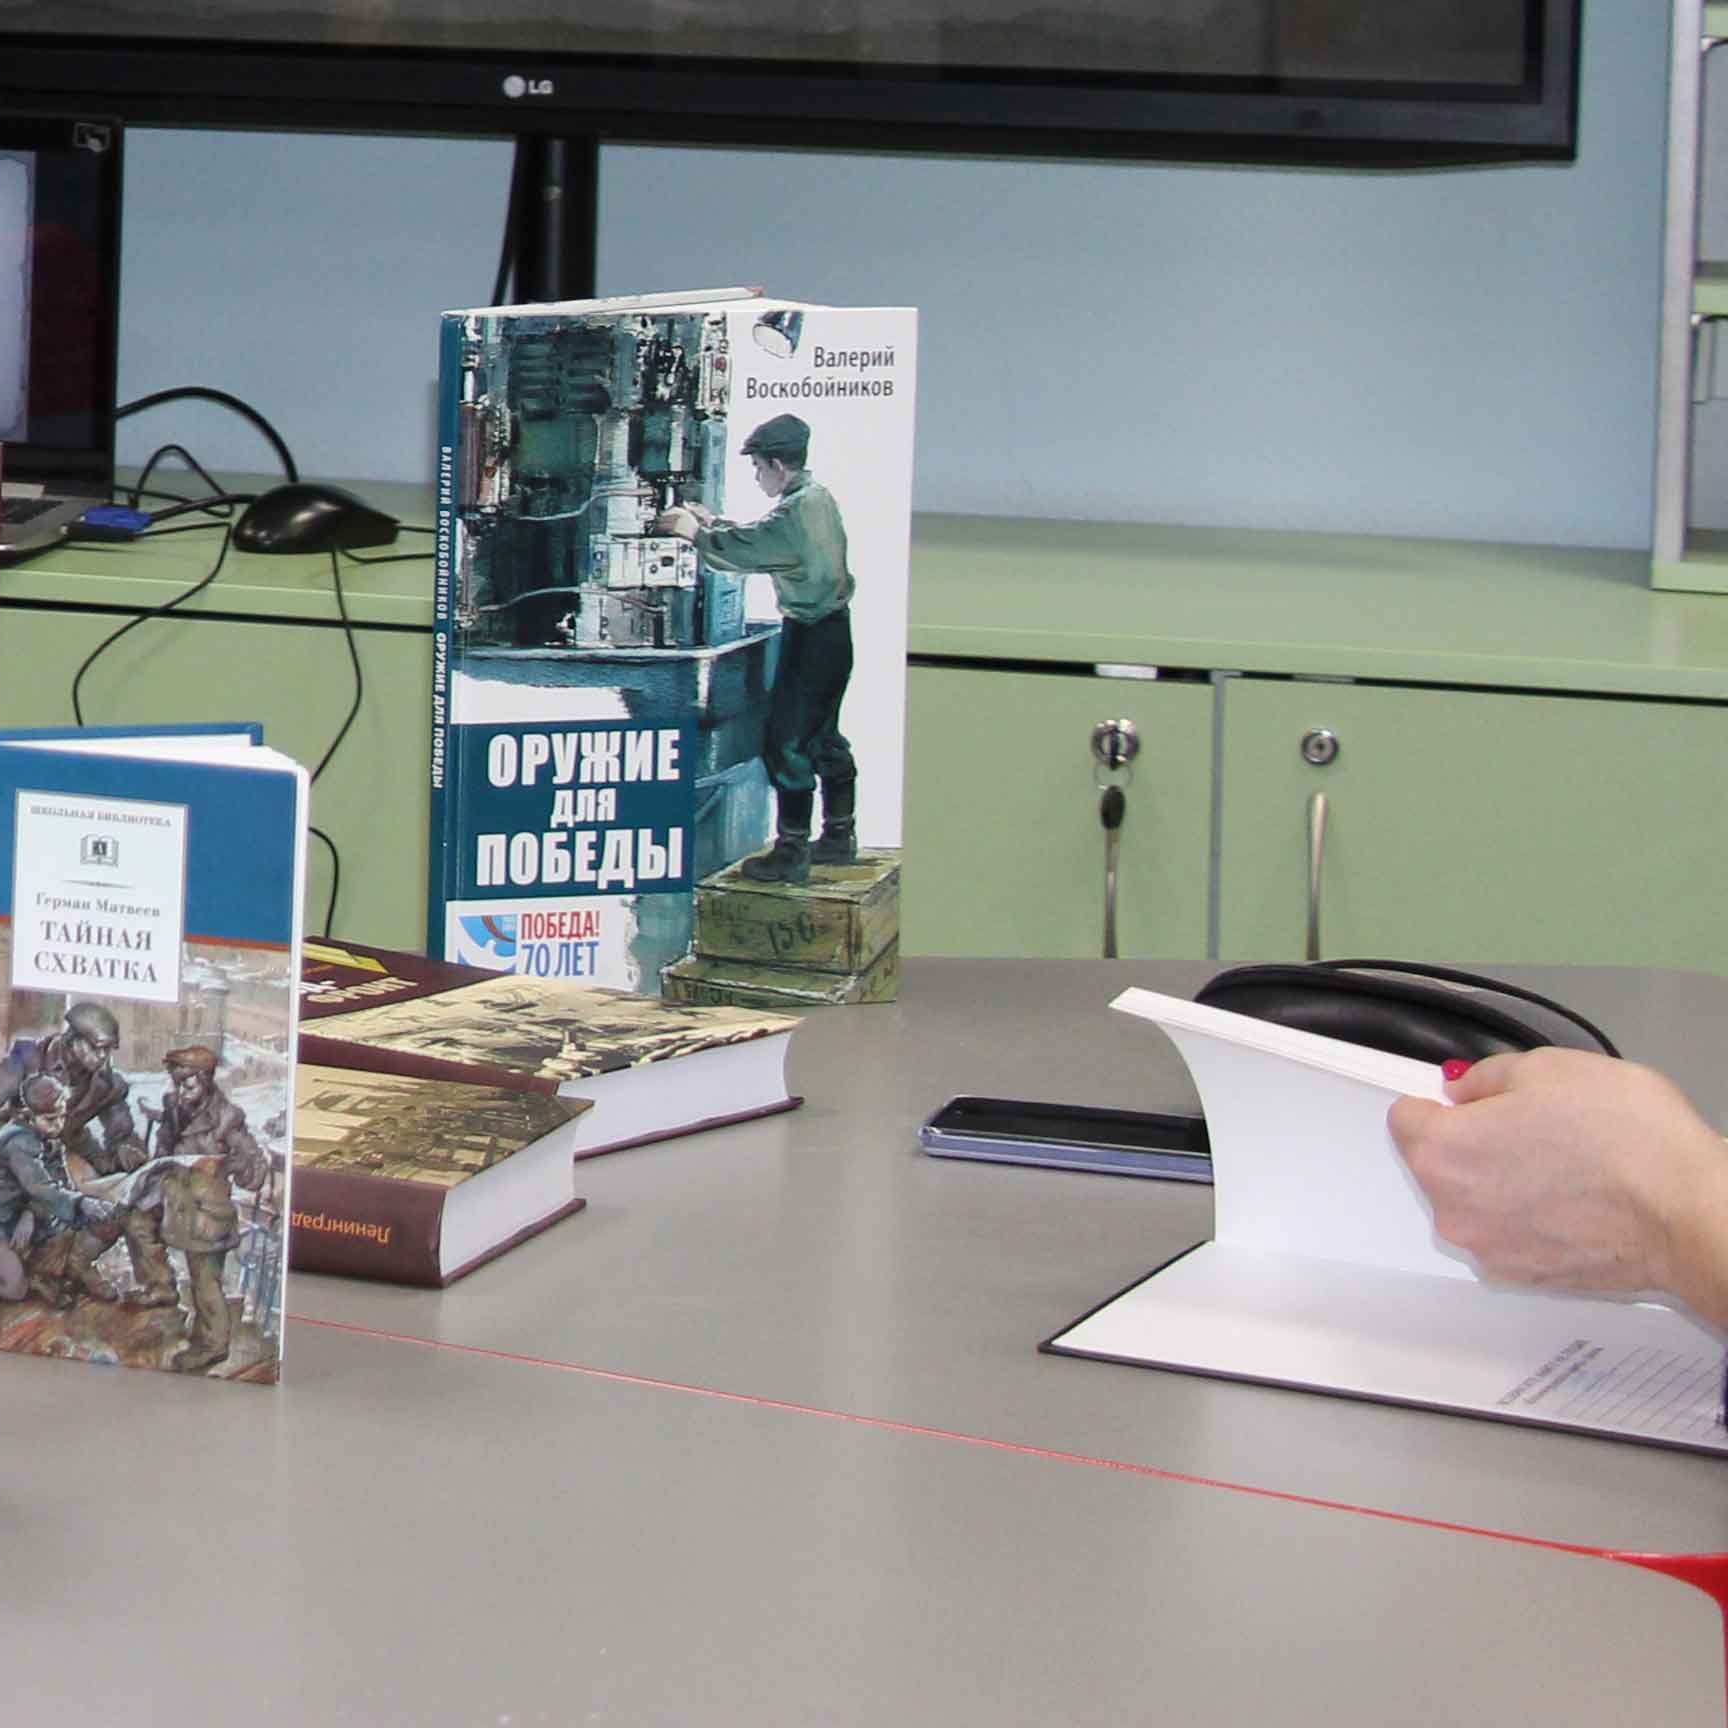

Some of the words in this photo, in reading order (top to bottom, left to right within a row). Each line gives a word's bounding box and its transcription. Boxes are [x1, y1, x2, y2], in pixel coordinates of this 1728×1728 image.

[528, 79, 554, 94] LG
[813, 345, 895, 372] Валерий
[746, 376, 894, 399] Воскобойников
[434, 632, 447, 692] ОРУЖИЕ
[432, 694, 446, 724] ДЛЯ
[431, 727, 445, 789] ПОБЕДЫ
[487, 729, 681, 788] ОРУЖИЕ
[30, 805, 95, 821] ШКОЛЬНАЯ
[97, 811, 172, 827] БИБЛИОТЕКА
[550, 787, 617, 828] ДЛЯ
[476, 827, 683, 890] ПОБЕДЫ
[35, 891, 91, 912] Герман
[95, 898, 161, 917] Матвеев
[40, 919, 152, 952] ТАЙНАЯ
[520, 910, 601, 940] ПОБЕДА!
[33, 950, 158, 984] СХВАТКА
[521, 943, 550, 976] 70
[555, 942, 599, 976] ЛЕТ
